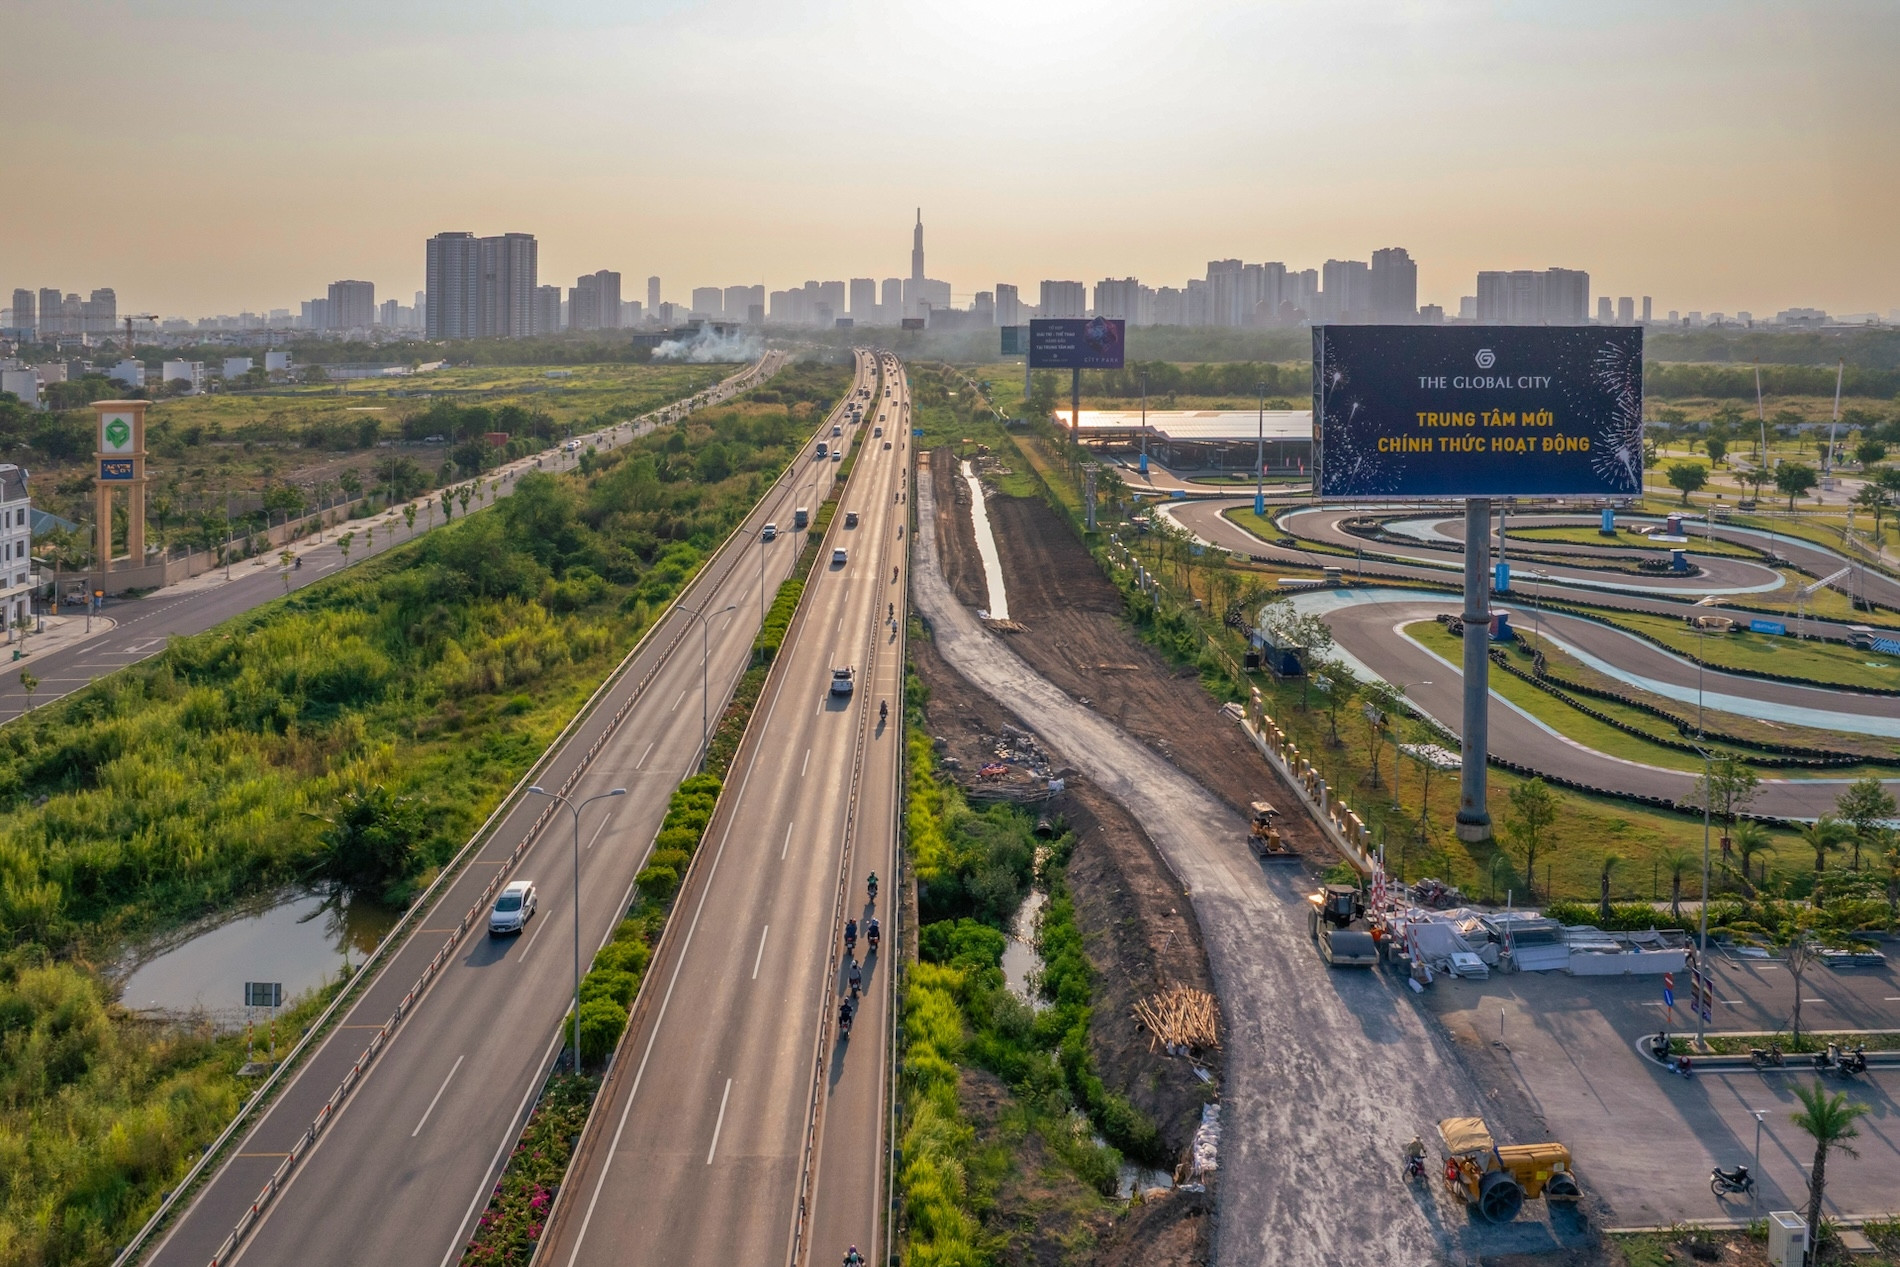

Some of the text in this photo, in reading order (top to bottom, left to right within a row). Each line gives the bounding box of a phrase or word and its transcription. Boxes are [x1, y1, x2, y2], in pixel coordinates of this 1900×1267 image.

[1418, 376, 1551, 389] THE GLOBAL CITY
[1416, 408, 1553, 427] TRUNG TÂM MỚI
[1377, 433, 1590, 455] CHÍNH THỨC HOẠT ĐỘNG
